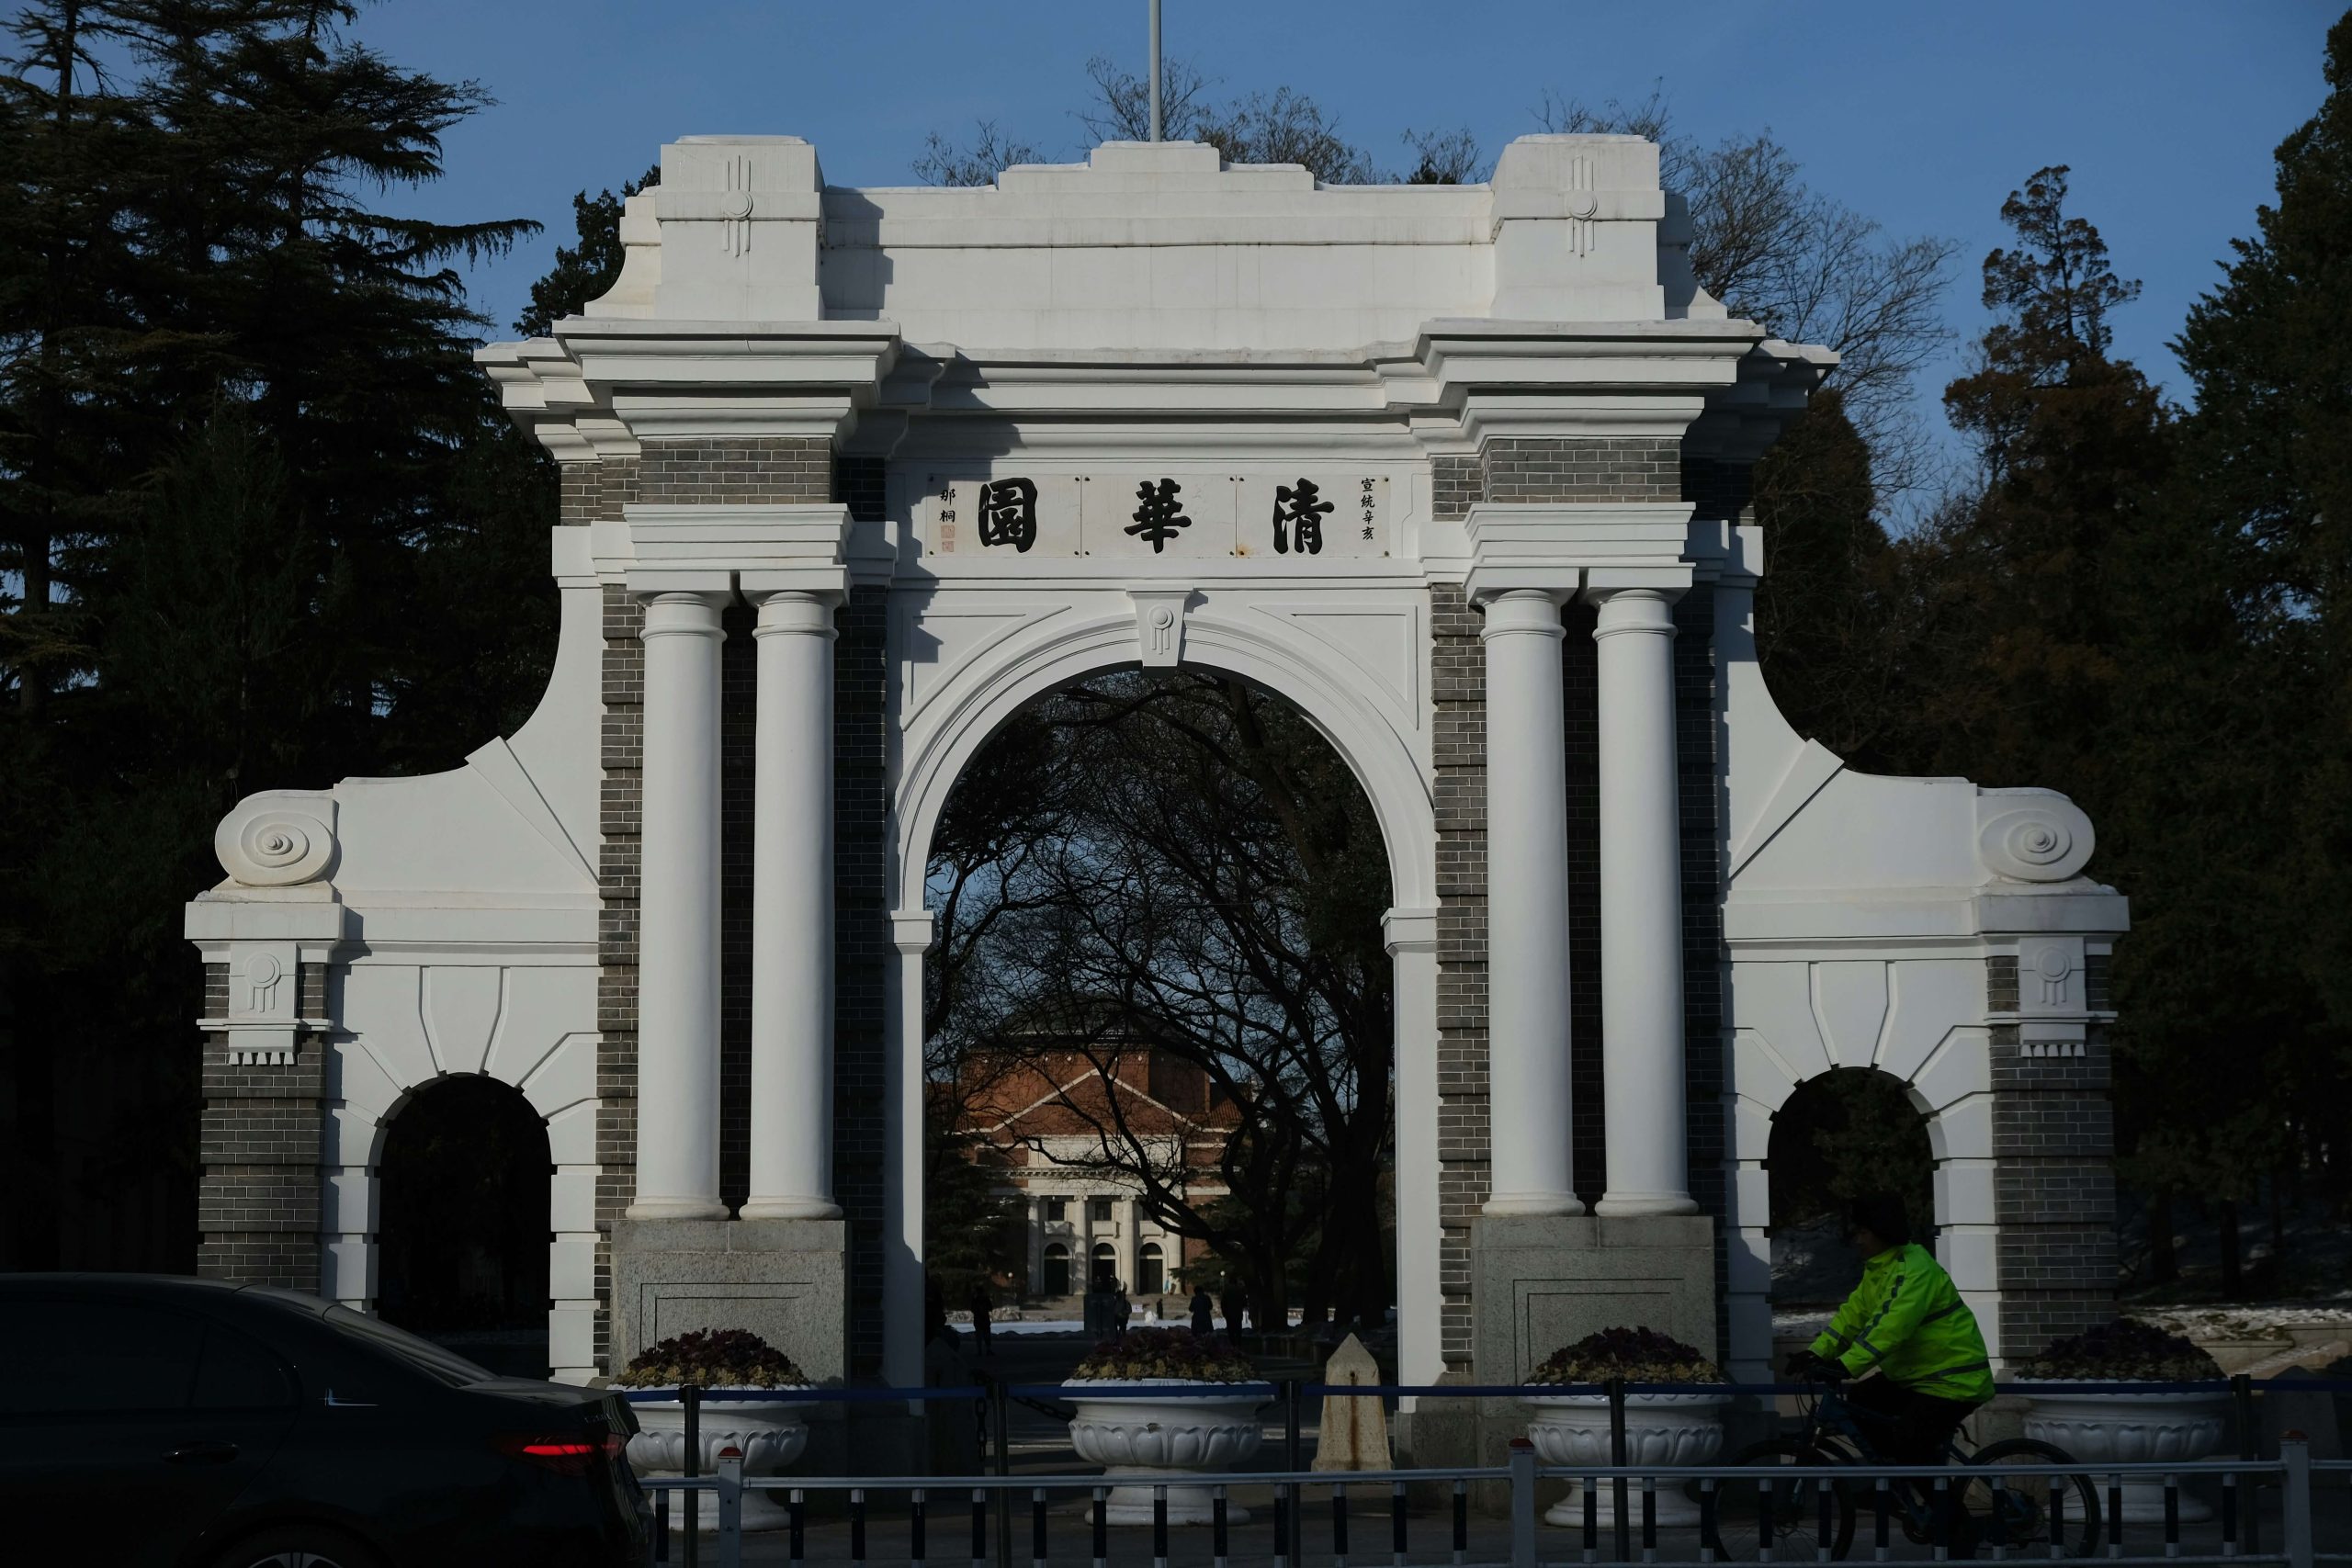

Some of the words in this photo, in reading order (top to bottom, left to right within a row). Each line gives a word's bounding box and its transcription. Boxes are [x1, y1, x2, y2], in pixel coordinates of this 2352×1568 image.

[939, 488, 956, 524] 那桐
[978, 477, 1335, 555] 清華園
[1361, 477, 1376, 540] 宣統辛亥
